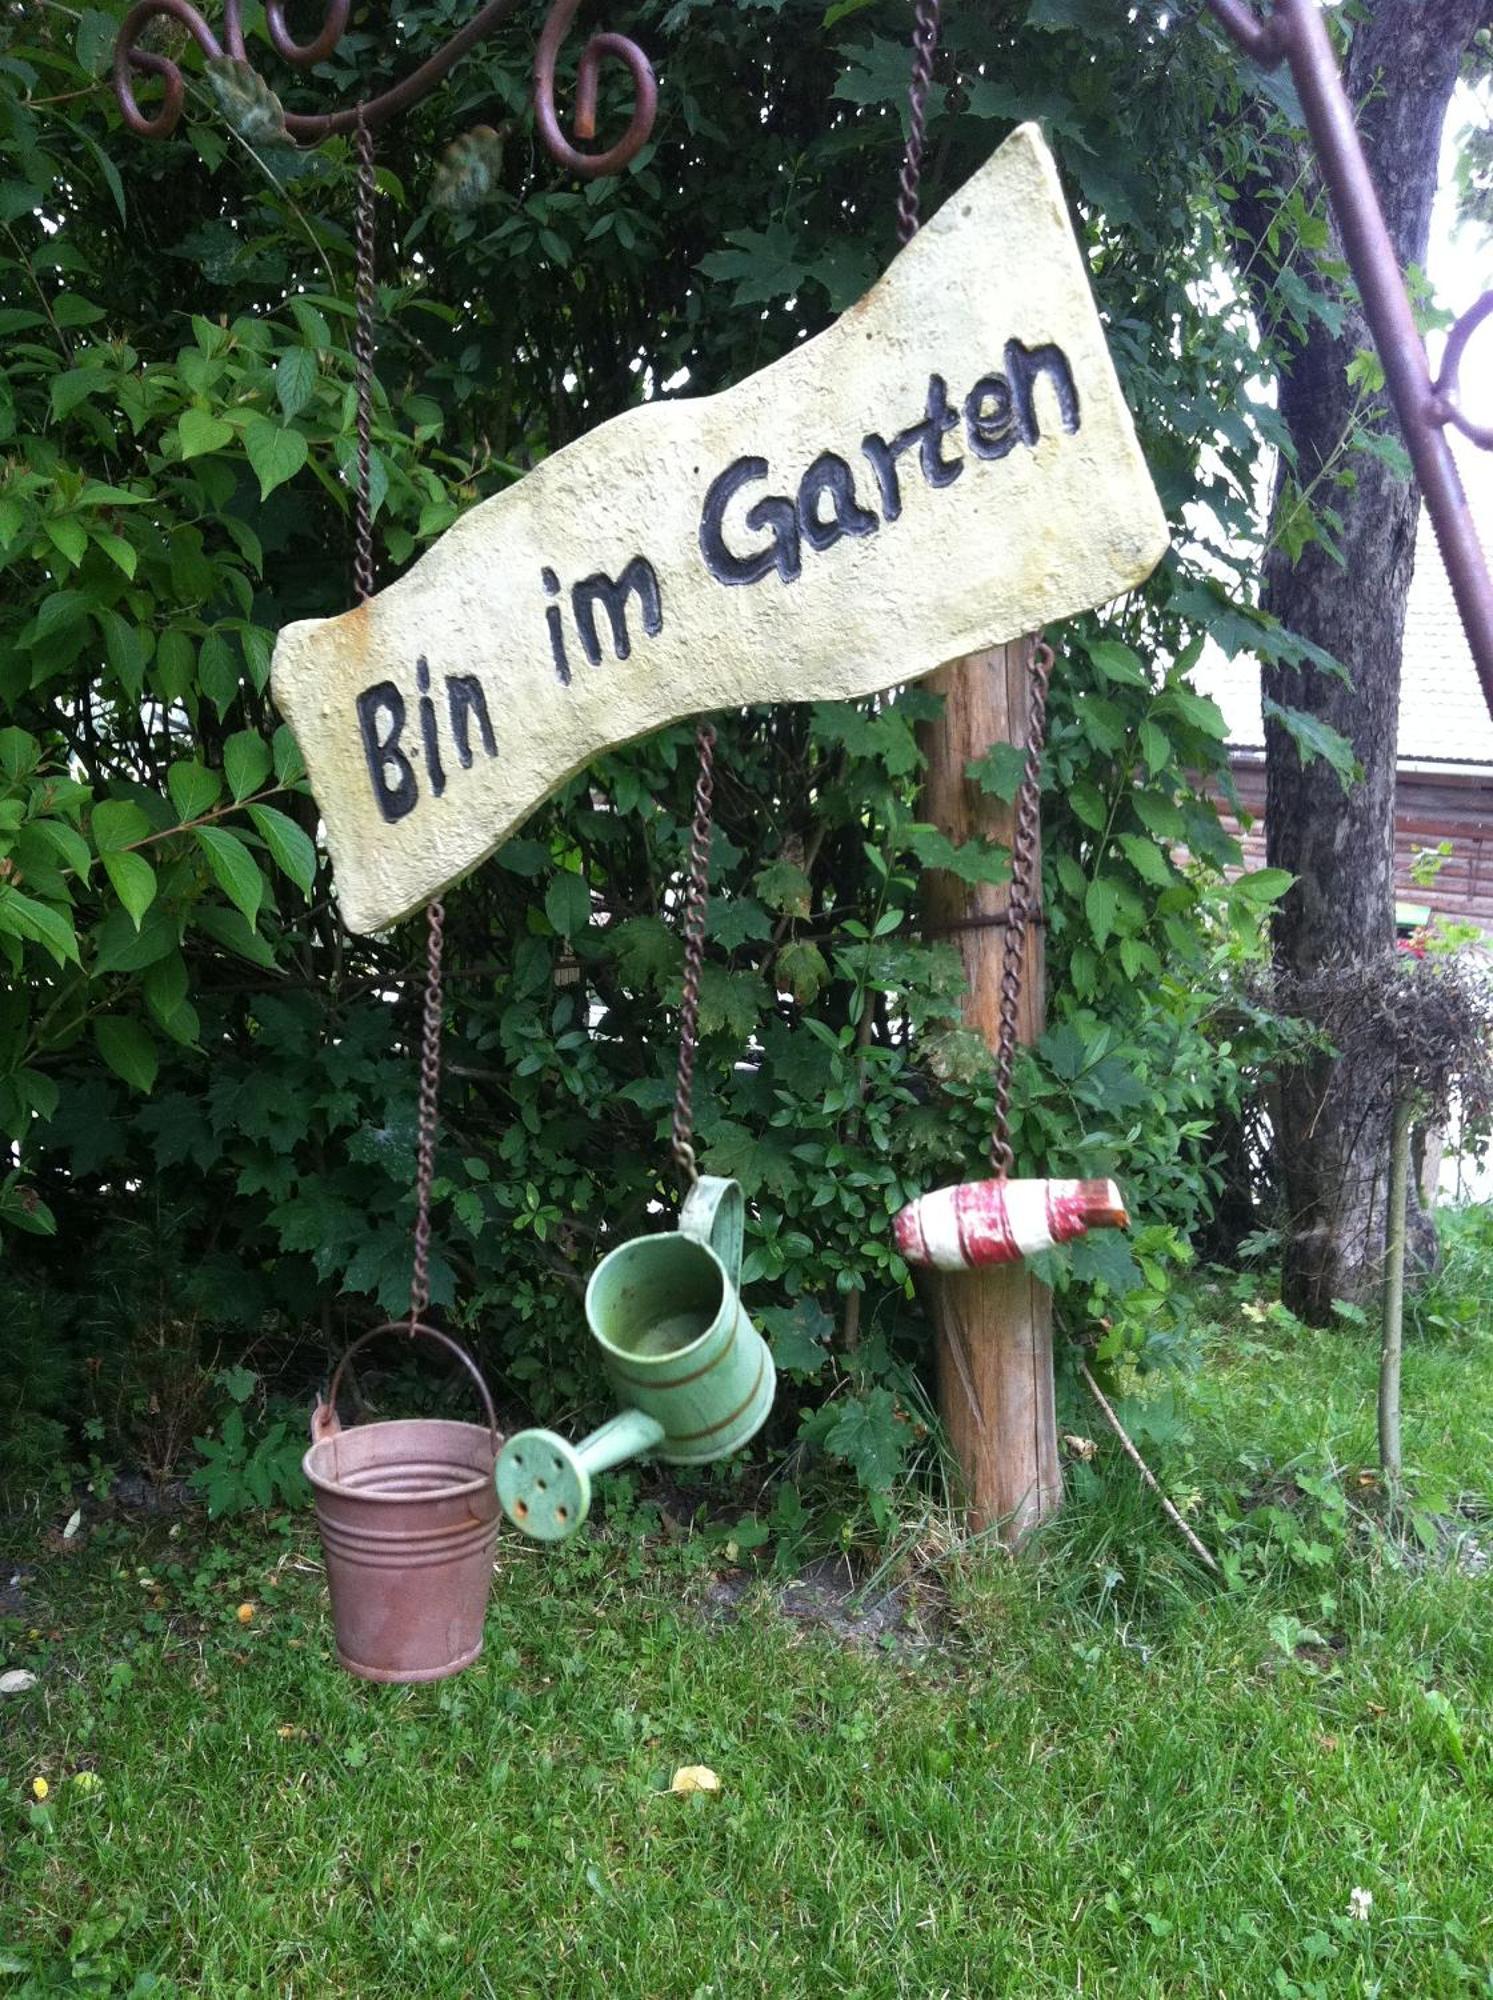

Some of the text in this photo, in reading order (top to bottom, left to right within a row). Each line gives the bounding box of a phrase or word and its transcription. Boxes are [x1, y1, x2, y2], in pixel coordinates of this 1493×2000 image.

[356, 338, 1081, 824] Bin im Garten
